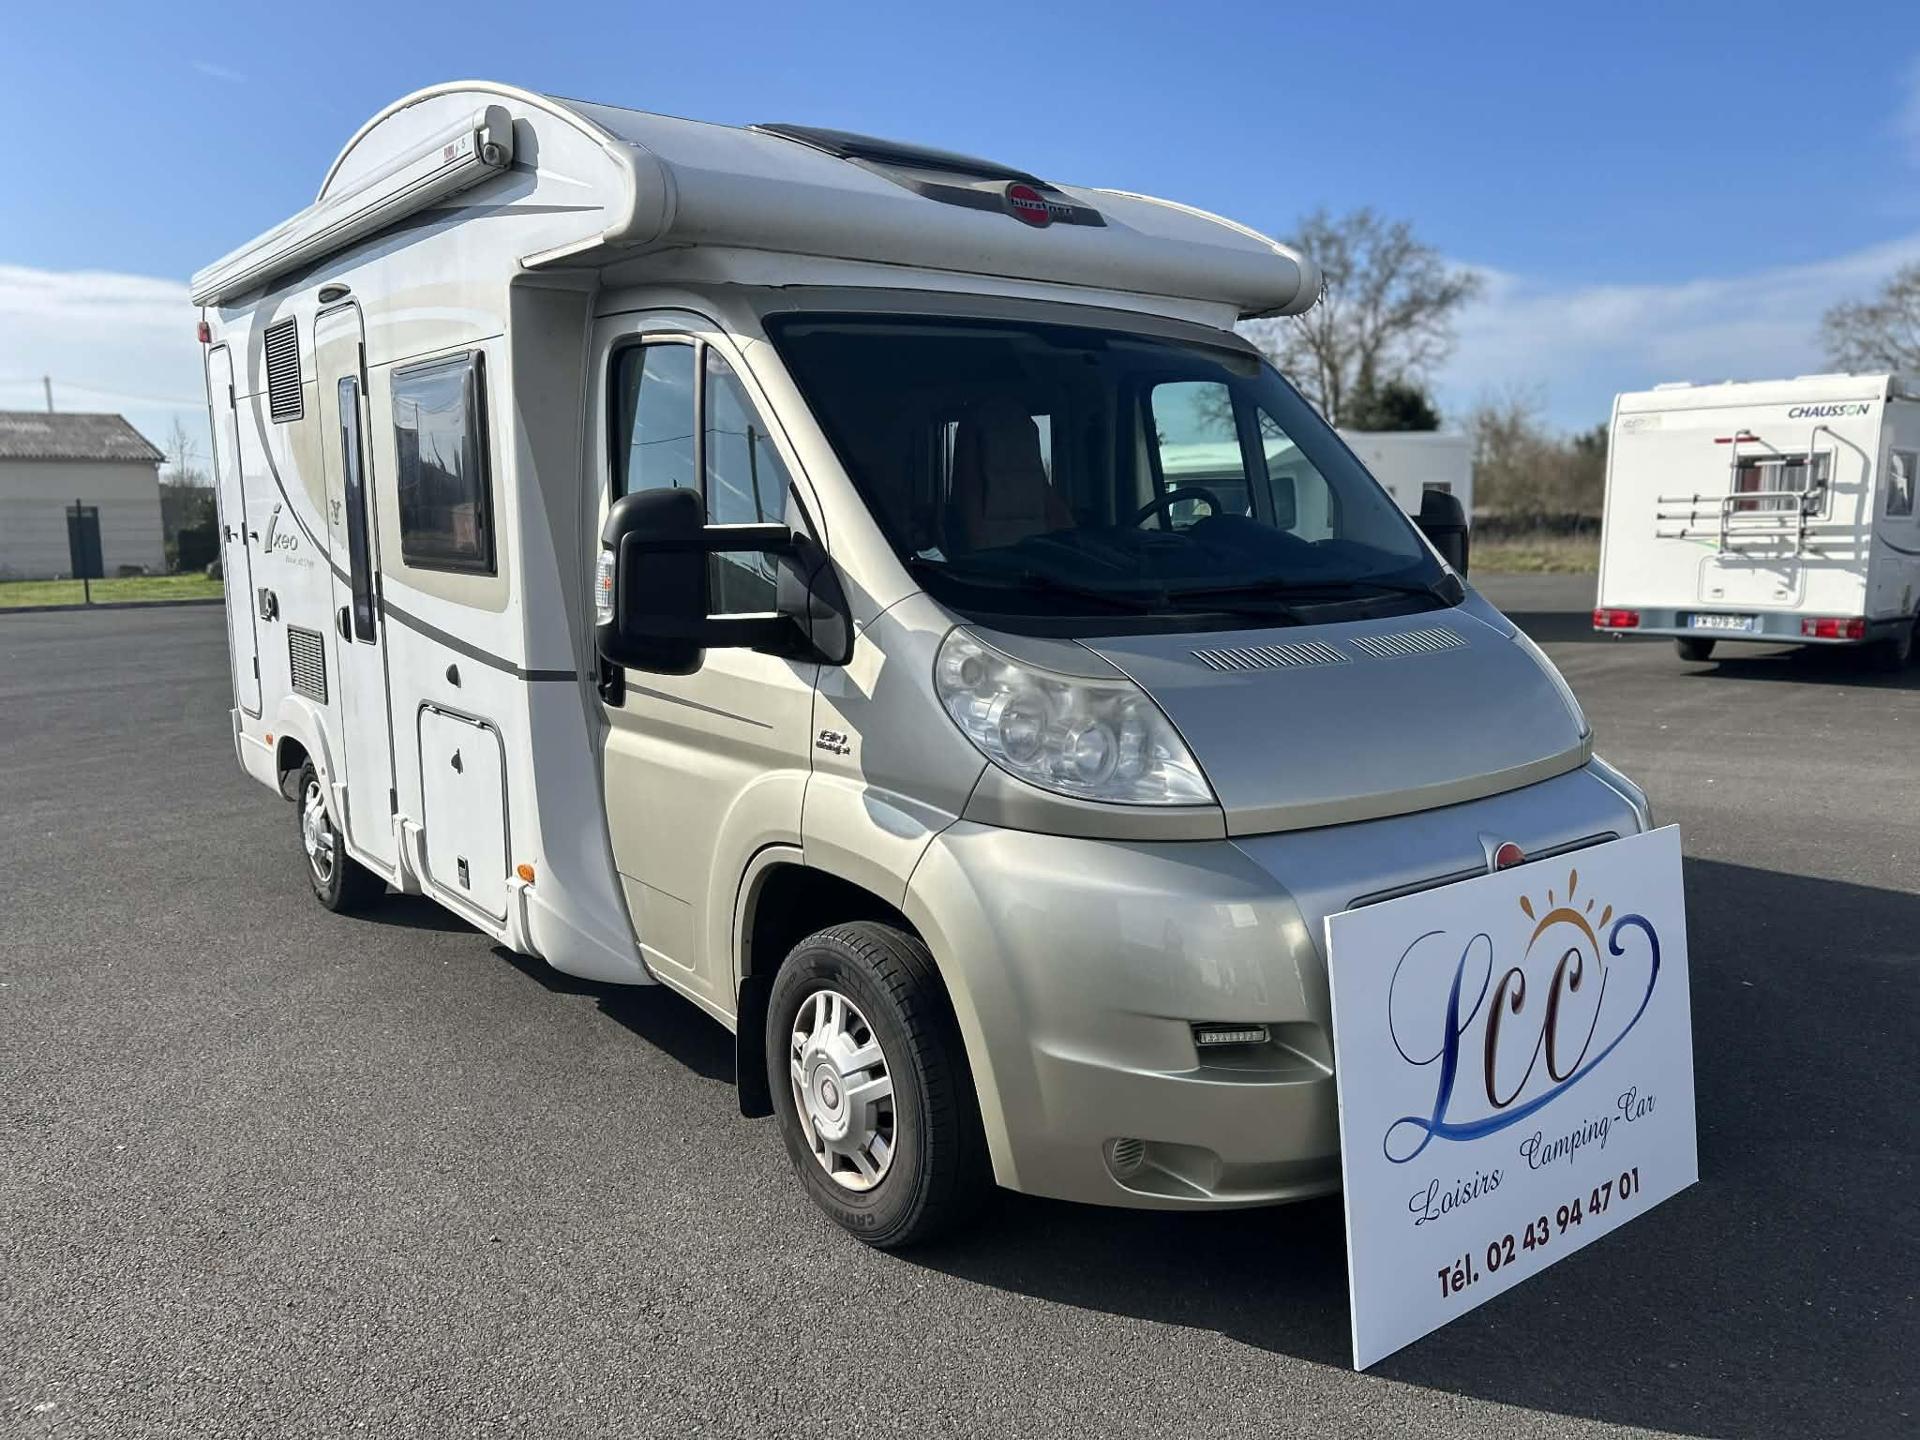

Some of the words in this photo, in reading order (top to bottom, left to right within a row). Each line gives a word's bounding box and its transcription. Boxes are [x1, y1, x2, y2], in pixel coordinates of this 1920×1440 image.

[1788, 403, 1870, 418] CHAUSSON
[1384, 913, 1661, 1163] LCC
[1408, 1169, 1504, 1226] Loisirs
[1519, 1086, 1656, 1170] Camping-Car
[1438, 1253, 1479, 1299] Tél.
[1486, 1234, 1516, 1273] 02
[1522, 1216, 1550, 1251] 43
[1556, 1198, 1583, 1235] 94
[1588, 1180, 1613, 1215] 47
[1618, 1166, 1640, 1200] 01
